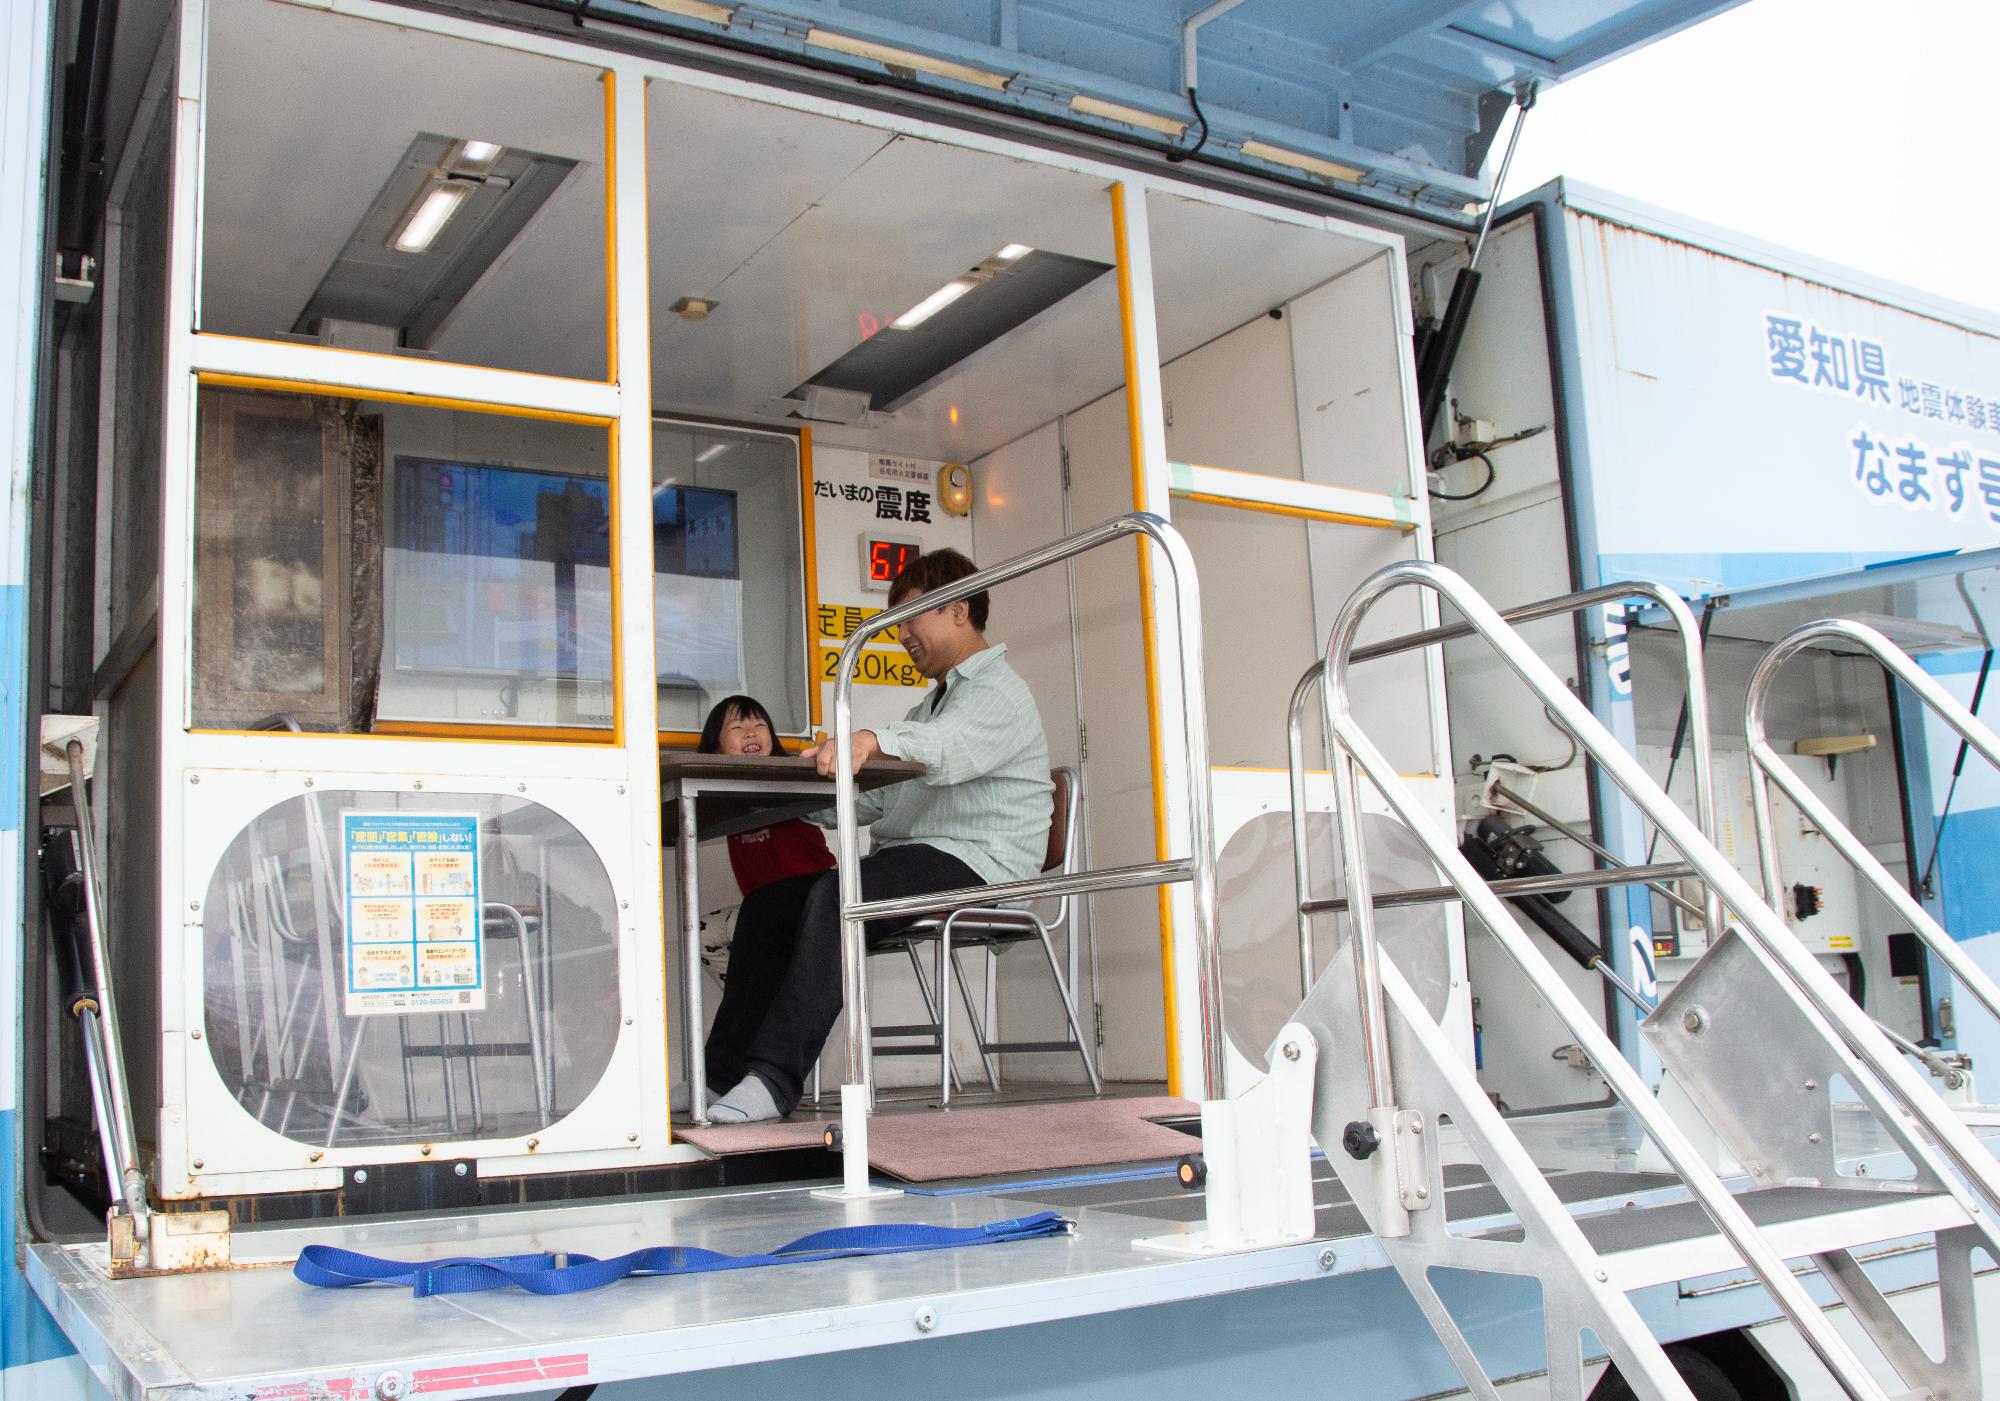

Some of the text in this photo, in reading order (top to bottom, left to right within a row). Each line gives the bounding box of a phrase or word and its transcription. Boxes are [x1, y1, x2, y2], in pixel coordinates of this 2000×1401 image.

[1766, 315, 2000, 433] 愛知県 地震体験車
[814, 480, 932, 524] だいまの震度
[1852, 431, 2000, 523] なまず号
